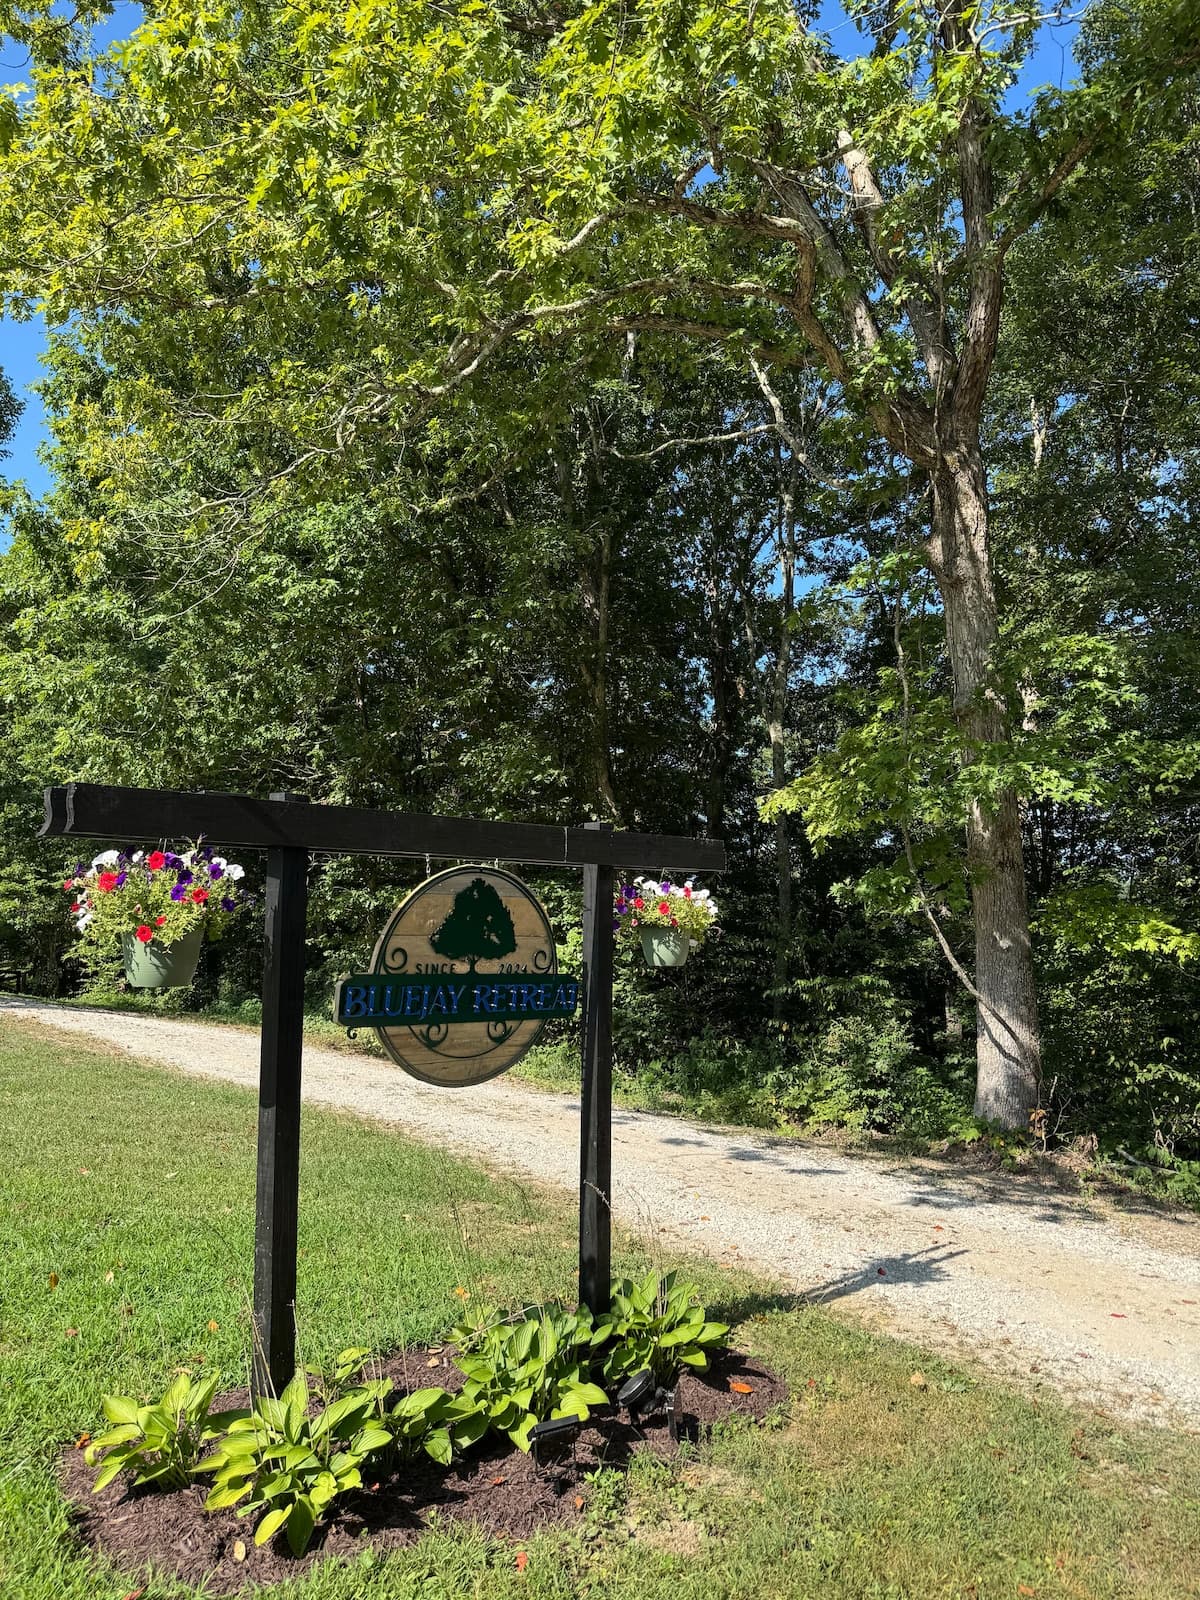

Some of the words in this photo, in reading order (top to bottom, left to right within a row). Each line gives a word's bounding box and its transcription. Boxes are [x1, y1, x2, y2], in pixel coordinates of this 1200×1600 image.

[416, 963, 456, 975] SINCE
[498, 963, 528, 975] 2024
[344, 984, 466, 1019] BLUEJAY
[472, 983, 578, 1012] RETREAT
